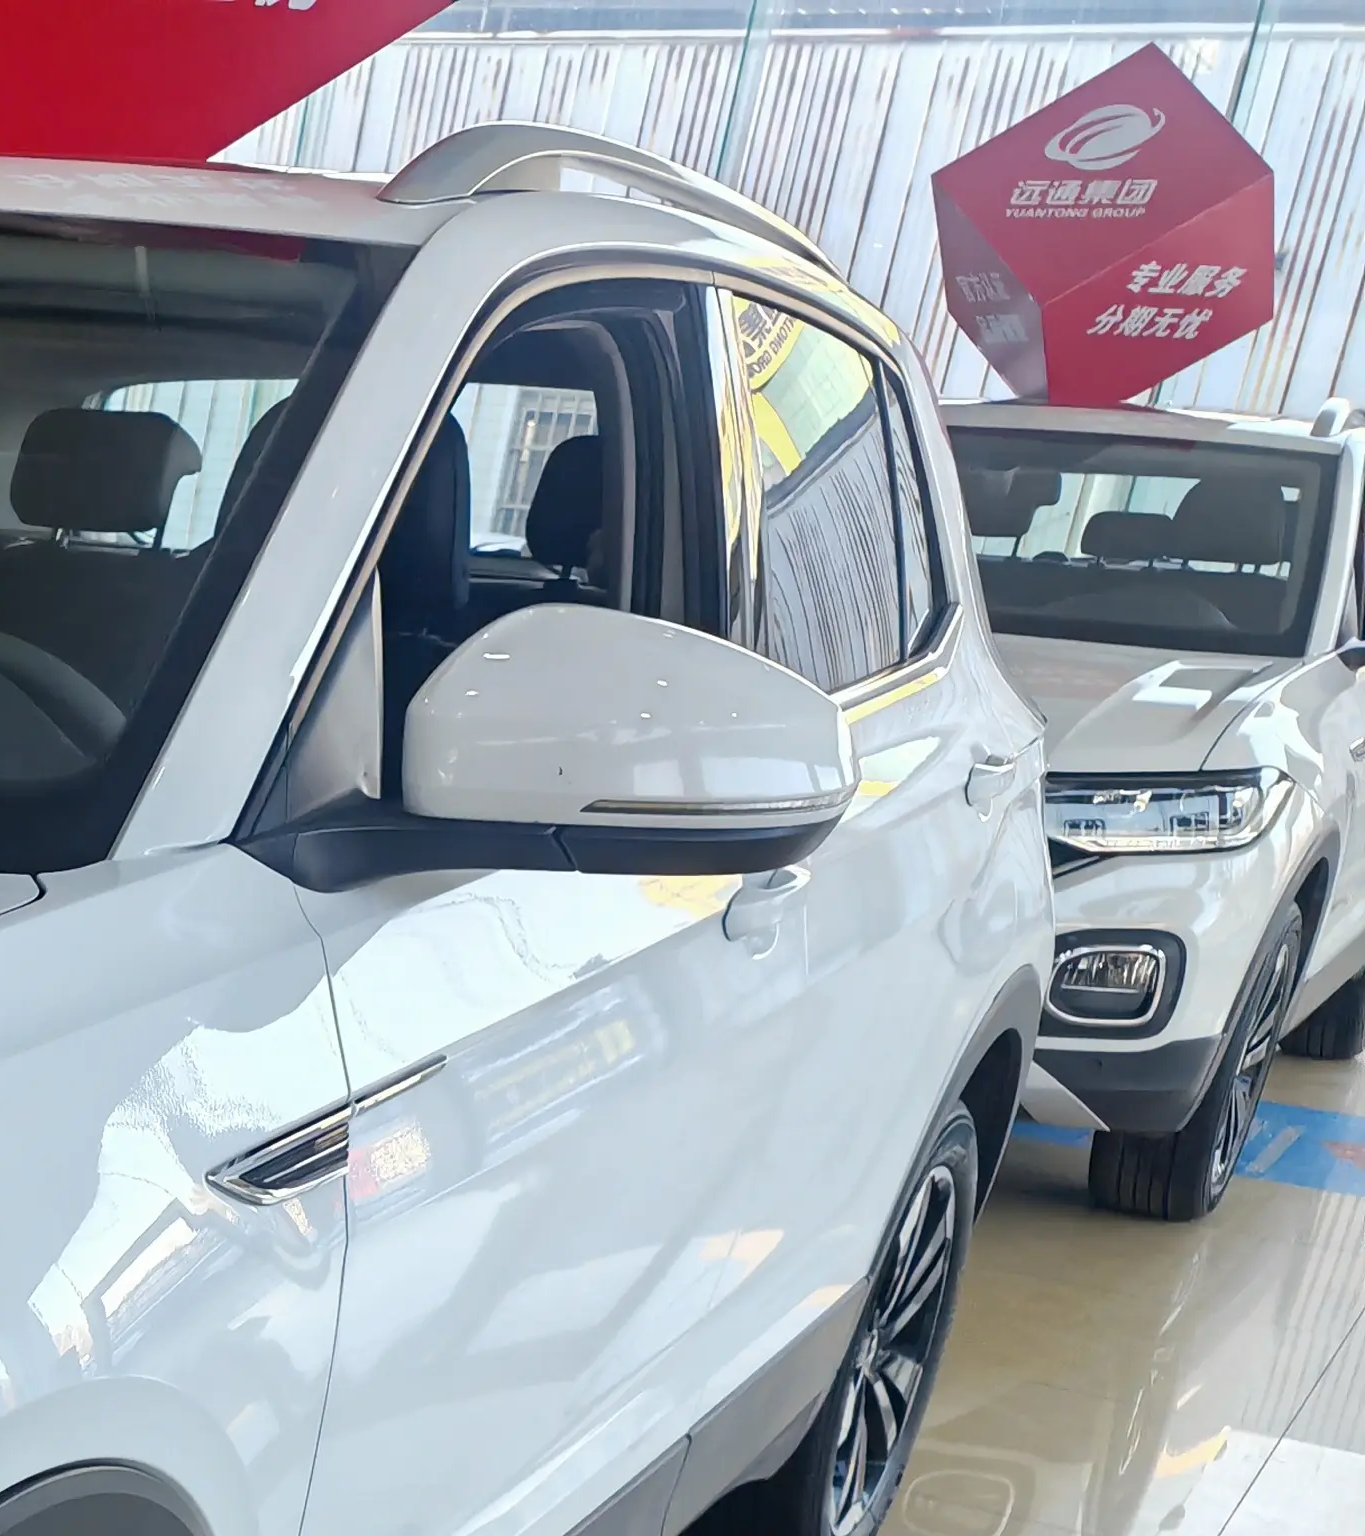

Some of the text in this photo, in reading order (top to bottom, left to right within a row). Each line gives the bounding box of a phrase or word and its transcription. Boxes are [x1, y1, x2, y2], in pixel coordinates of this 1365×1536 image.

[1009, 178, 1158, 206] 远通集团
[1005, 206, 1147, 219] YUANTONG GROUP
[1126, 259, 1248, 298] 专业服务
[1086, 304, 1214, 341] 分期无忧
